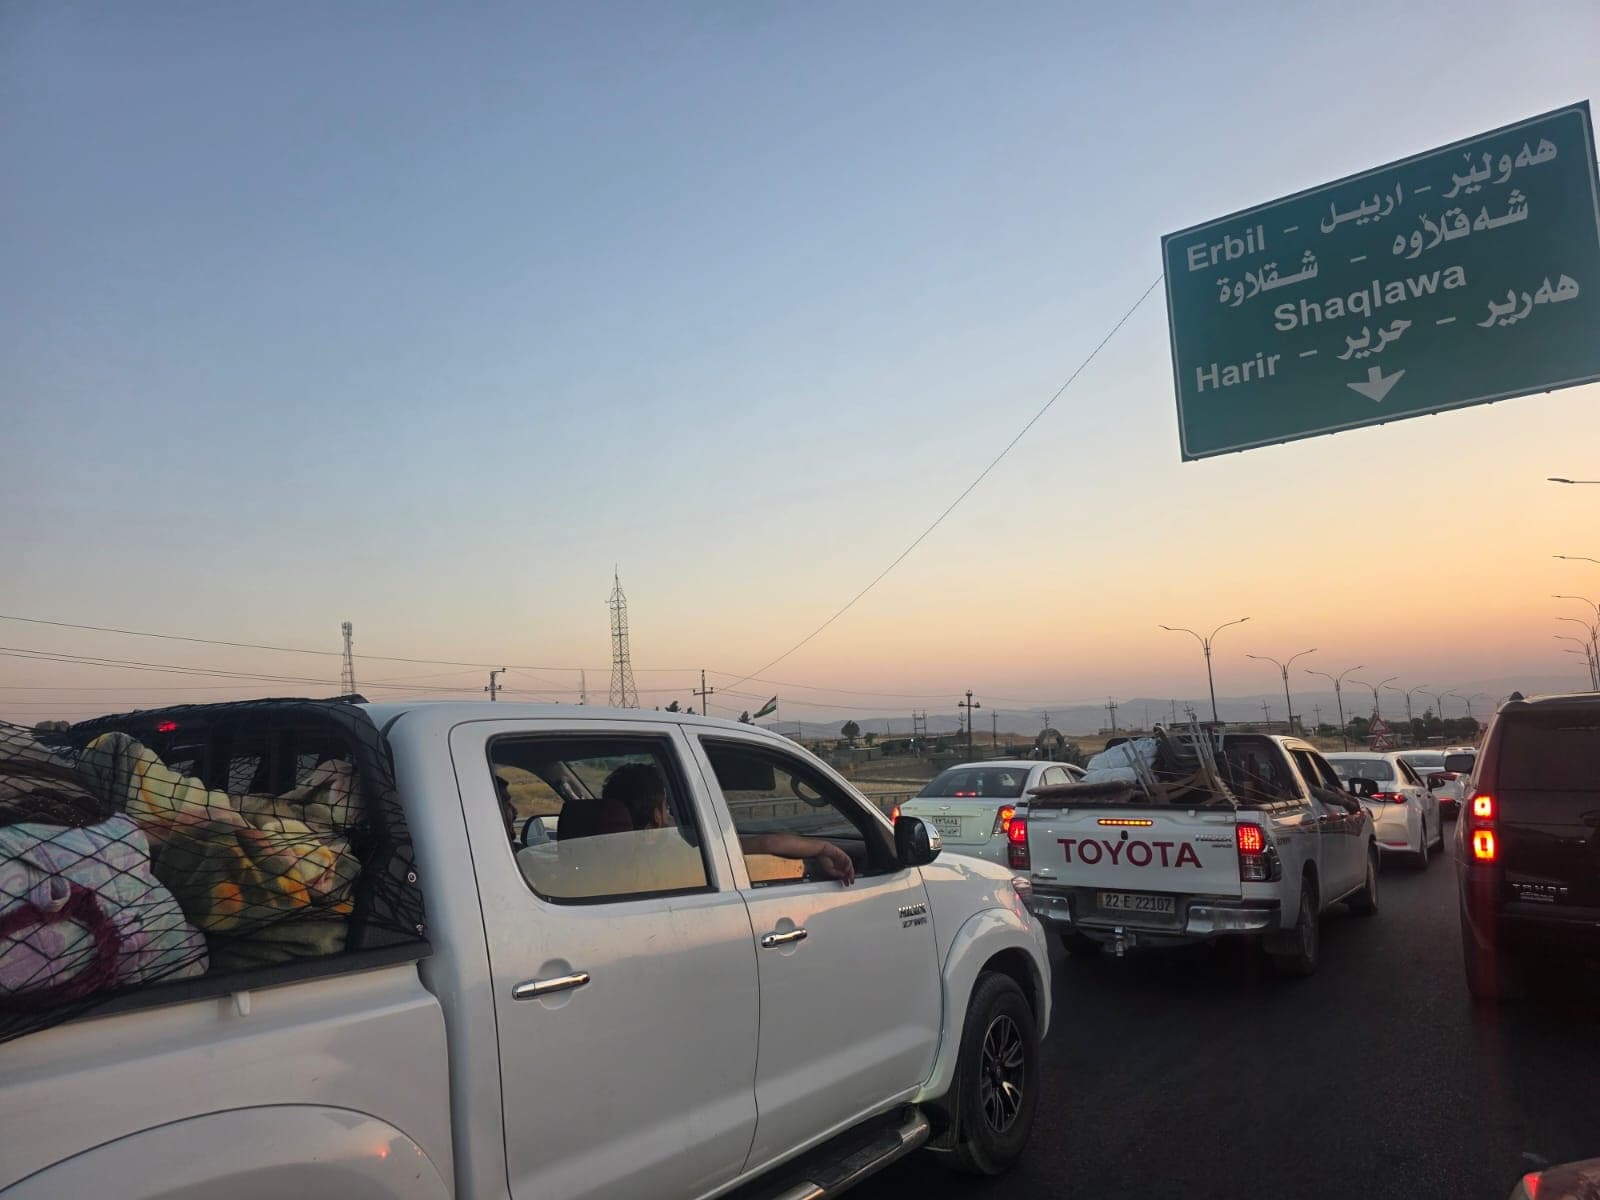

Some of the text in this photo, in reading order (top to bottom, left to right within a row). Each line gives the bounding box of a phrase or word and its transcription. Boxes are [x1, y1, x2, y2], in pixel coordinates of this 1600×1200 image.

[1186, 224, 1265, 272] Erbil
[1274, 265, 1467, 332] Shaqlawa
[1196, 351, 1281, 393] Harir
[1057, 838, 1203, 868] TOYOTA
[1105, 894, 1120, 908] 22
[1123, 895, 1131, 909] E
